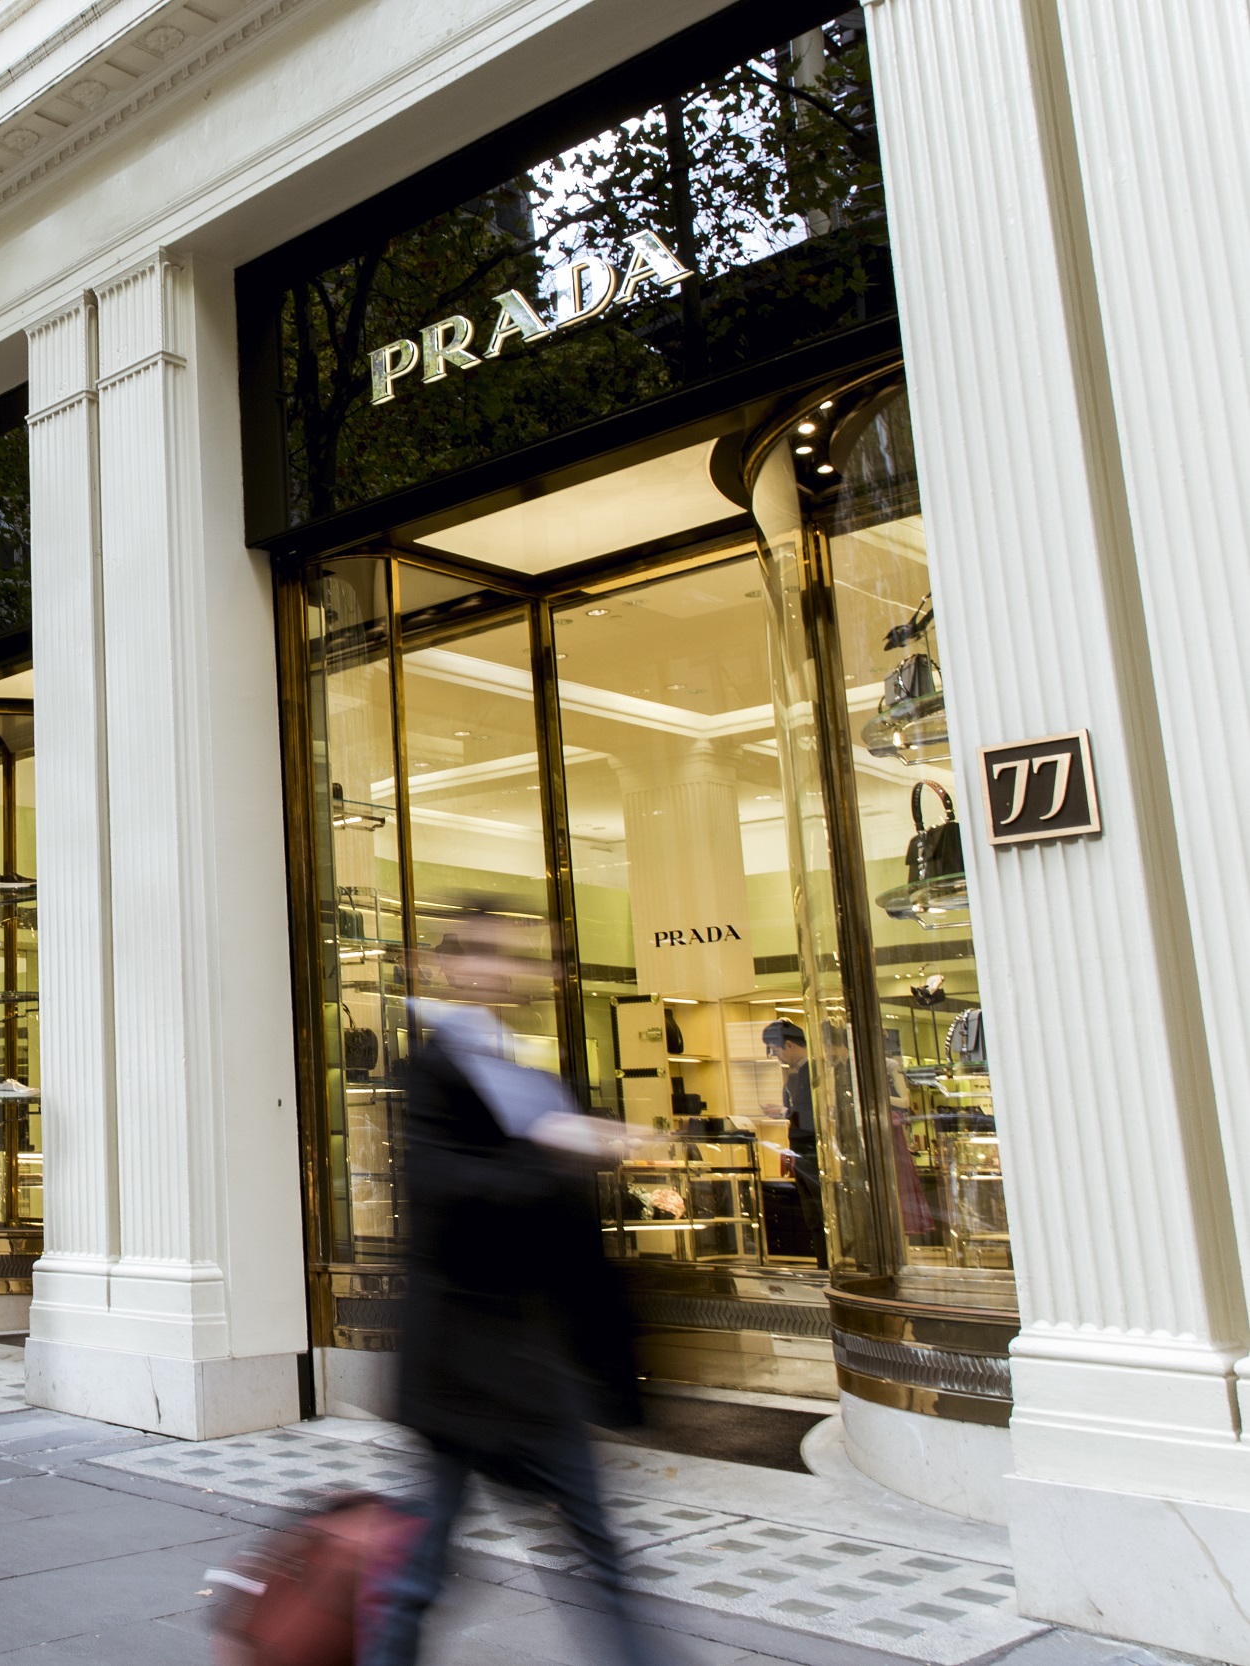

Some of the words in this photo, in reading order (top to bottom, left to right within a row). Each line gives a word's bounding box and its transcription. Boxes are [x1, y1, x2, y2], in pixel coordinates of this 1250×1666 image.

[368, 229, 695, 405] PRADA
[992, 752, 1072, 825] 77
[654, 924, 742, 948] PRADA
